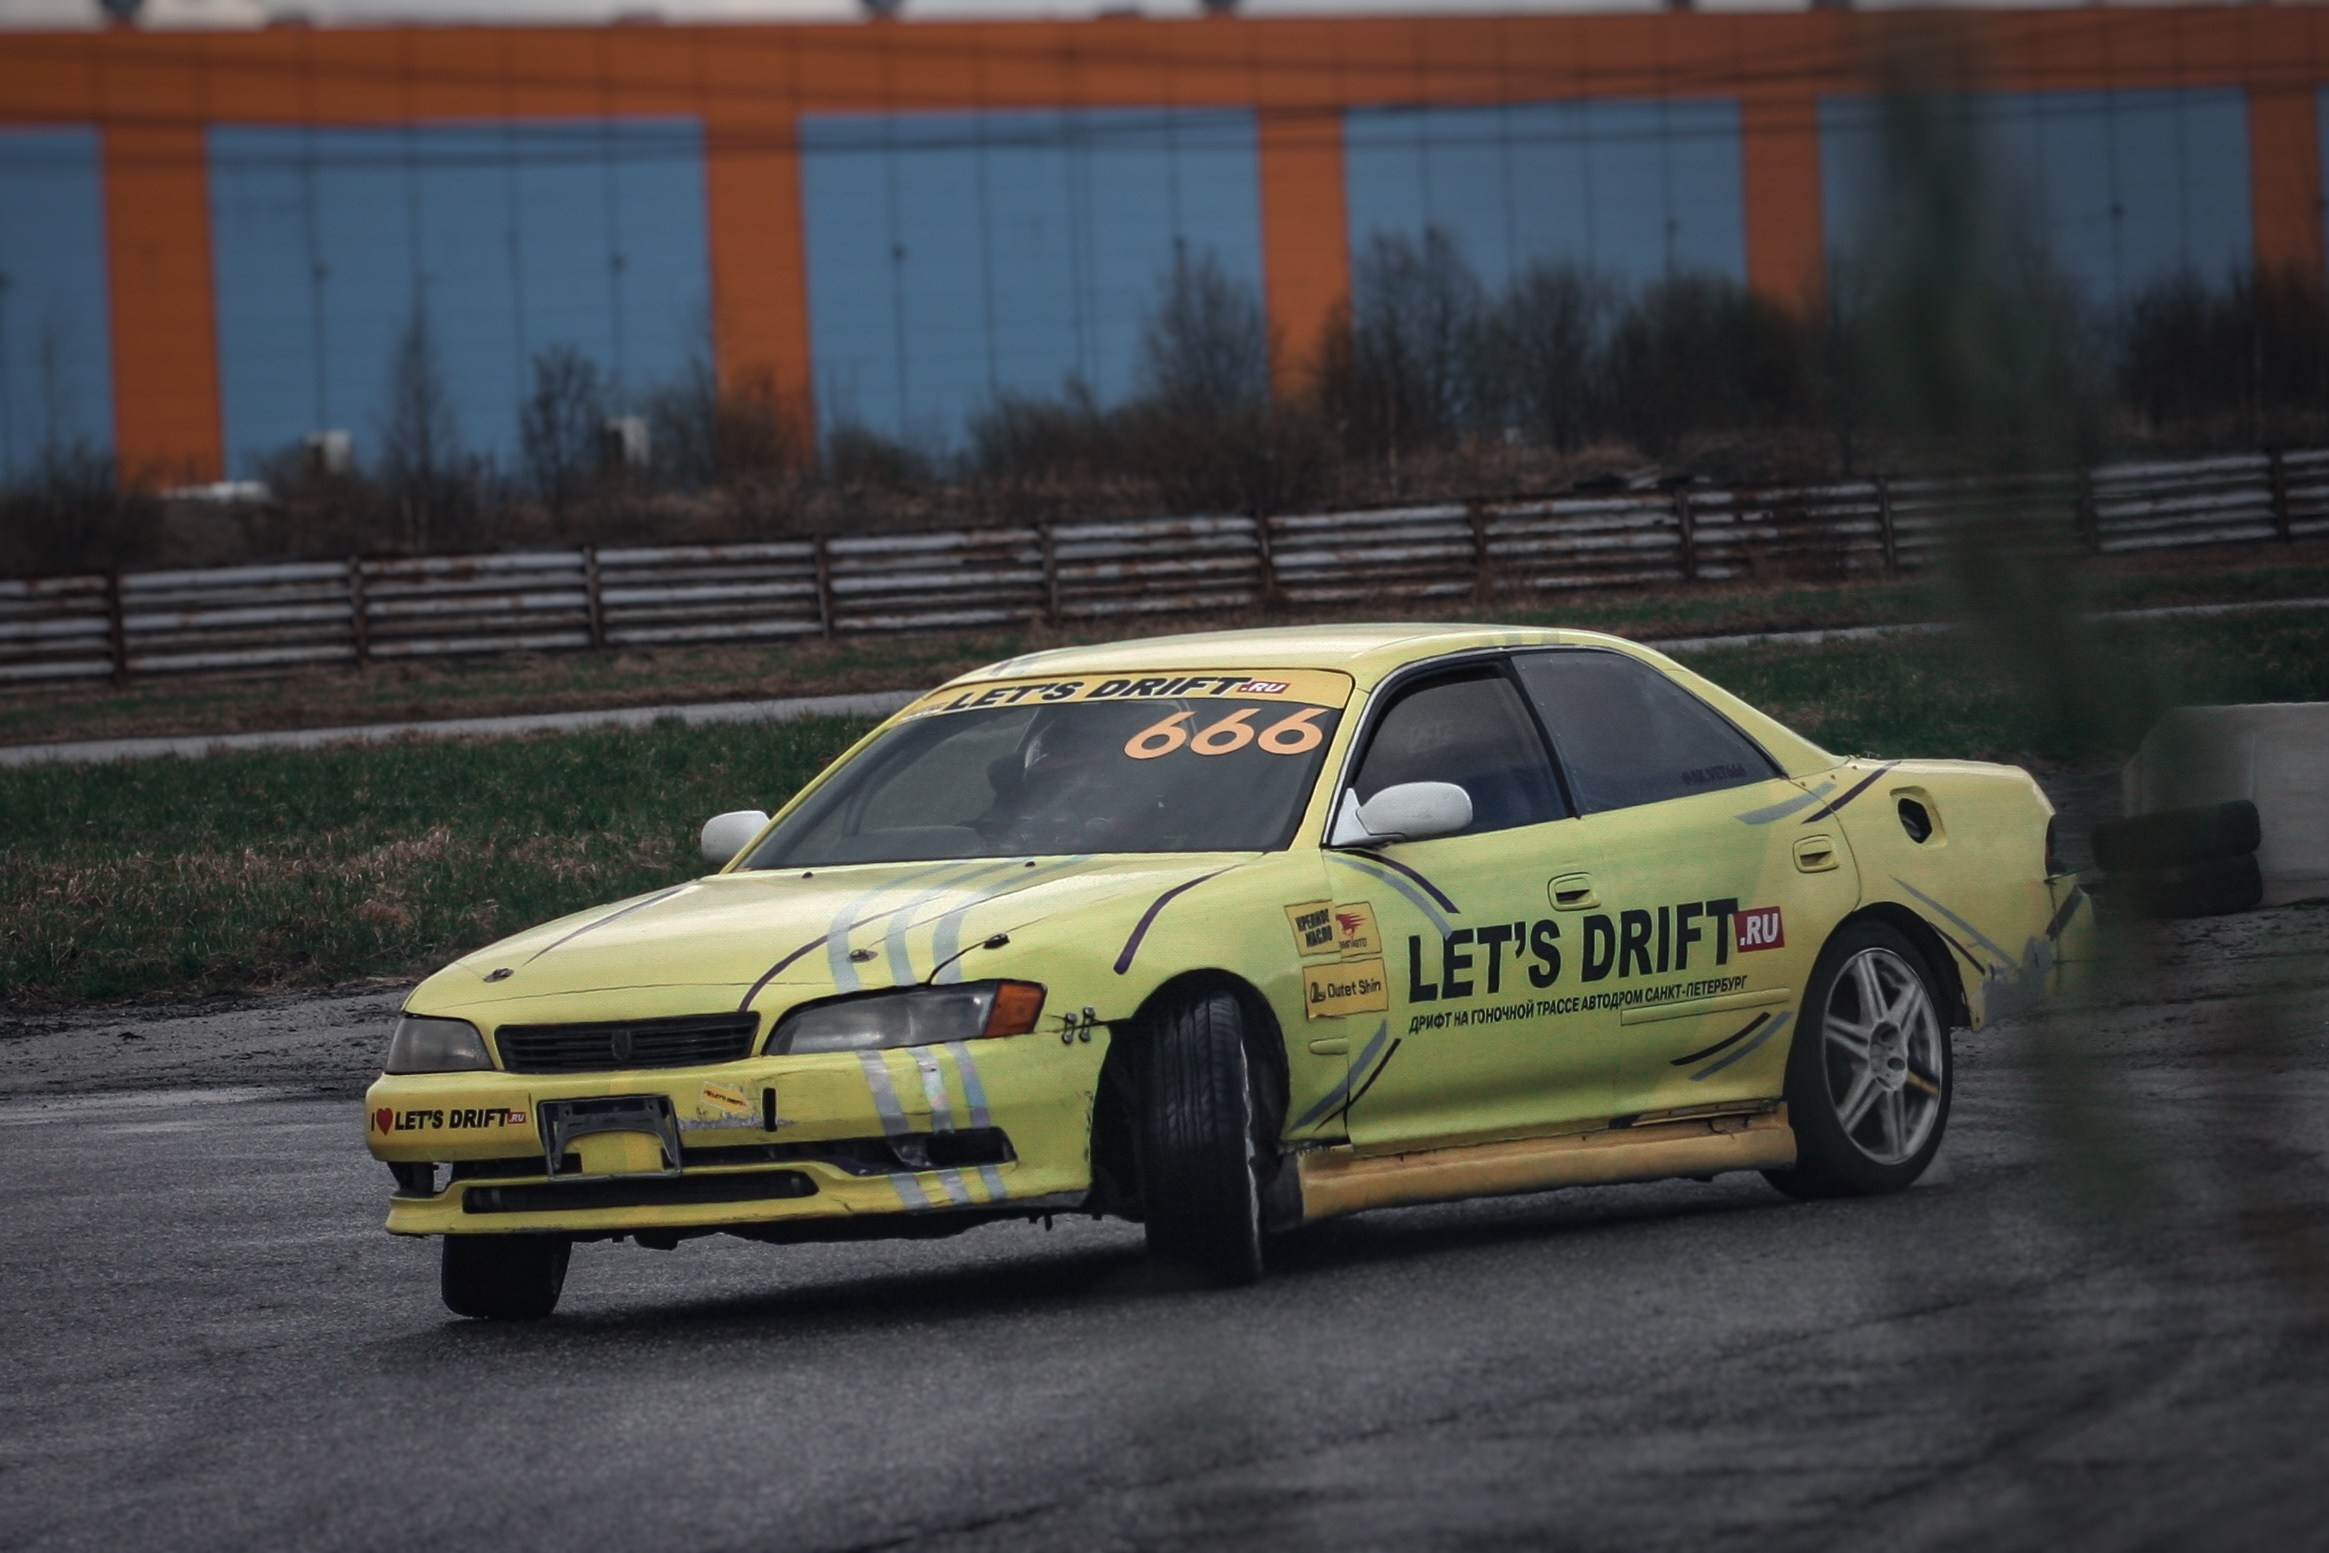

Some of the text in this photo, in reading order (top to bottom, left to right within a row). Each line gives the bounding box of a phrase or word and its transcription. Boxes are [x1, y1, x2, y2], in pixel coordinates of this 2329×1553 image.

[941, 681, 1085, 711] LET'S
[1123, 707, 1329, 760] 666
[1408, 919, 1562, 1004] LET'S
[1408, 974, 1748, 1035] ДРИФТ НА ГОНОЧНОЙ ТРАССЕ АВТОДРОМ САНКТ-ПЕТЕРБУРГ
[394, 1109, 444, 1131] LET'S
